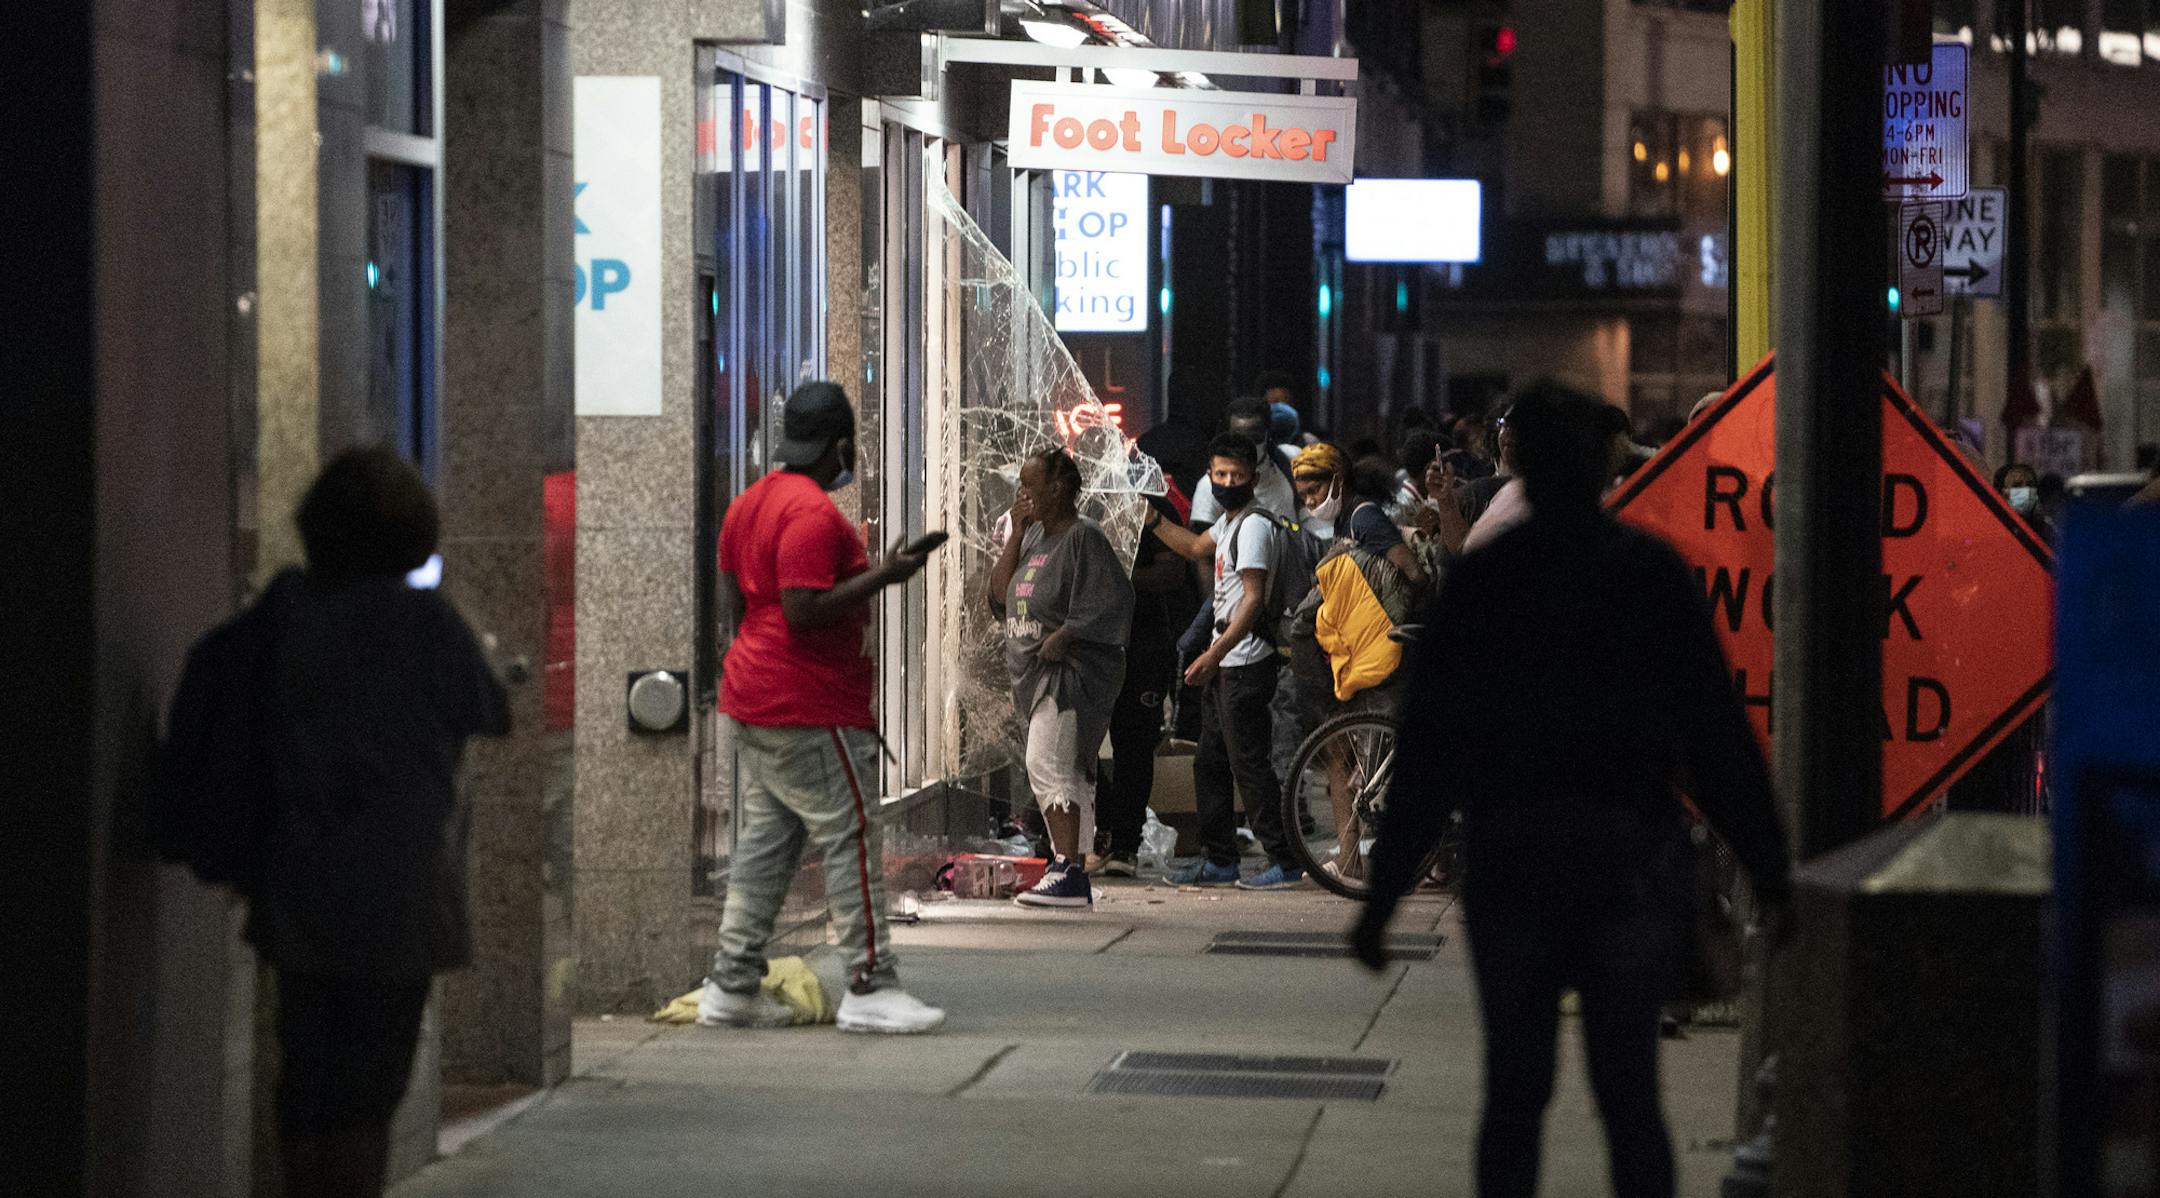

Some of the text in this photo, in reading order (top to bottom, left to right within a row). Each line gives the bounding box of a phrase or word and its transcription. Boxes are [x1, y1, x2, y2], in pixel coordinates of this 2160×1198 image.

[1030, 104, 1336, 162] Foot Locker
[1704, 465, 1928, 538] RD
[1697, 565, 1923, 640] WK
